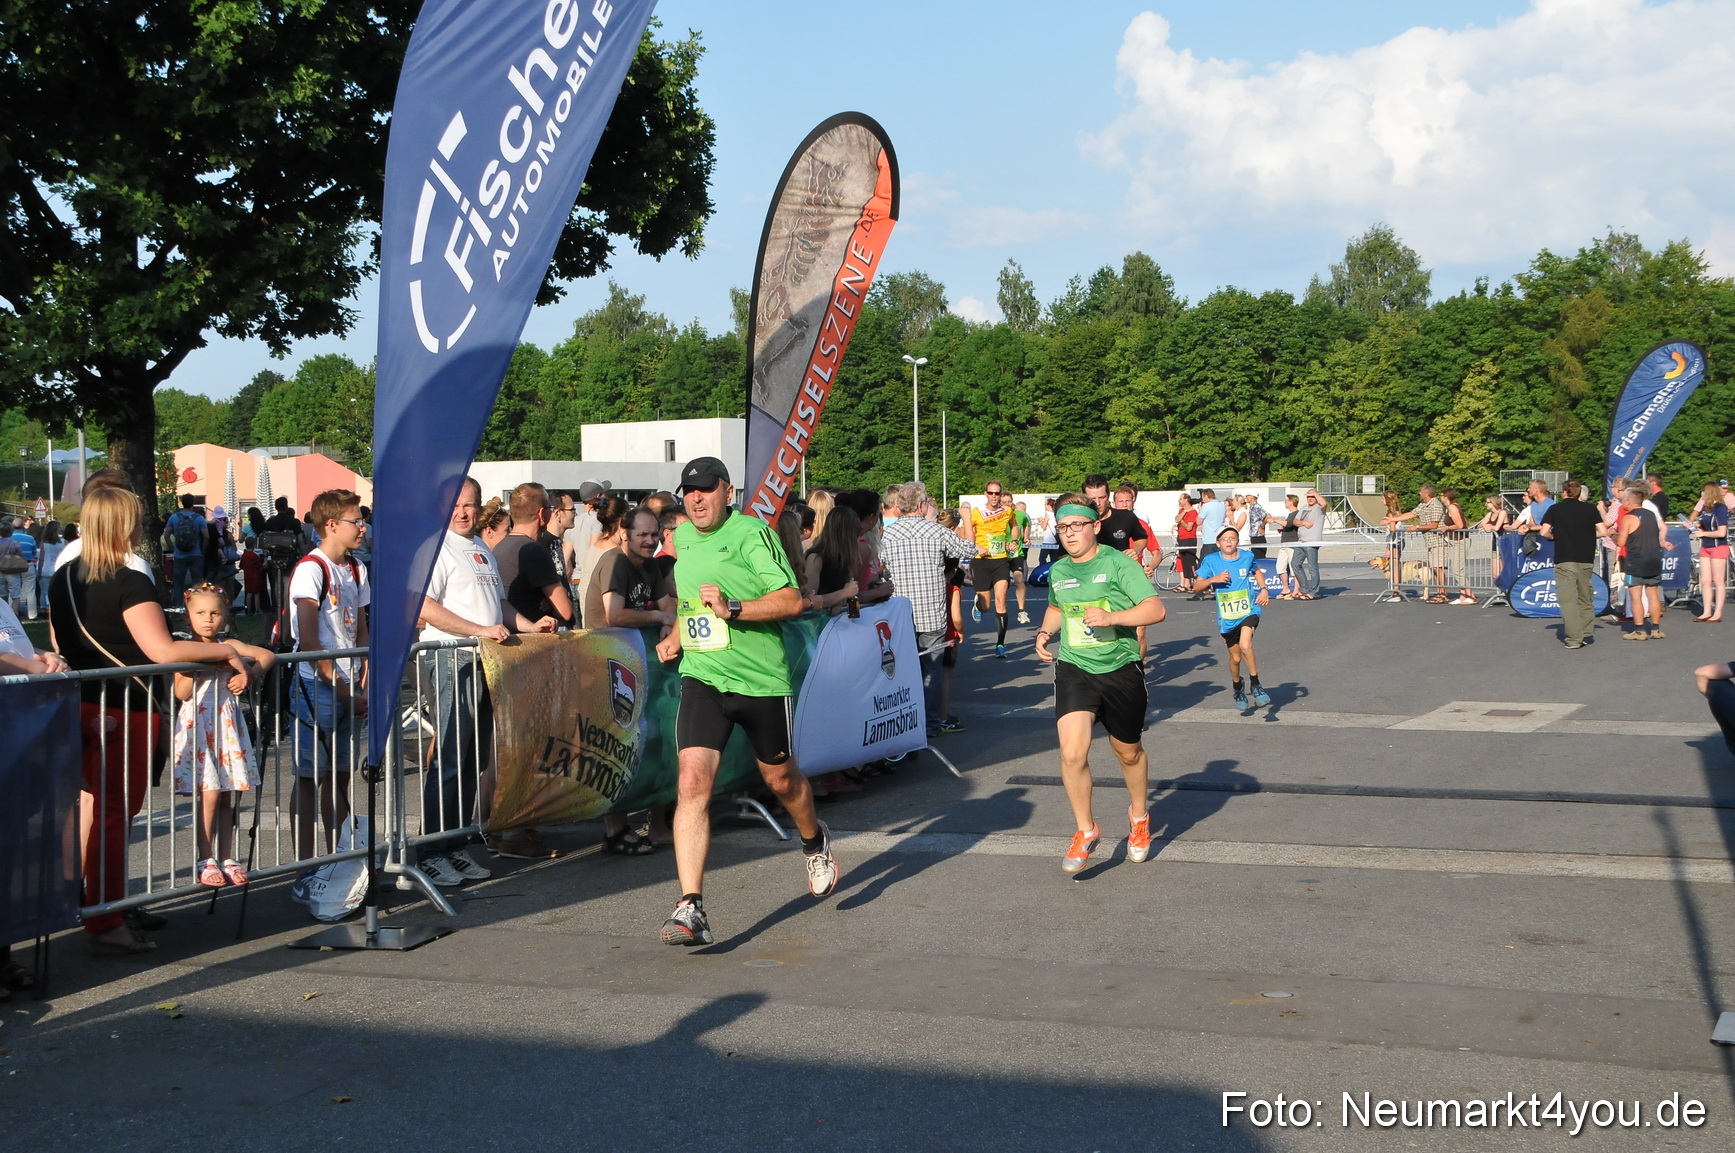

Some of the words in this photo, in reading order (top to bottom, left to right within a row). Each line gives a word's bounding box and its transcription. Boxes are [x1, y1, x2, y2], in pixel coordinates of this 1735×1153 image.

[492, 0, 613, 283] AUTOMOBILE
[991, 541, 1003, 550] 791
[1220, 599, 1249, 613] 1178
[687, 616, 711, 638] 88
[873, 686, 911, 714] Neumarkter
[863, 705, 918, 747] Lammsbräu
[572, 713, 640, 778] Neumarkt
